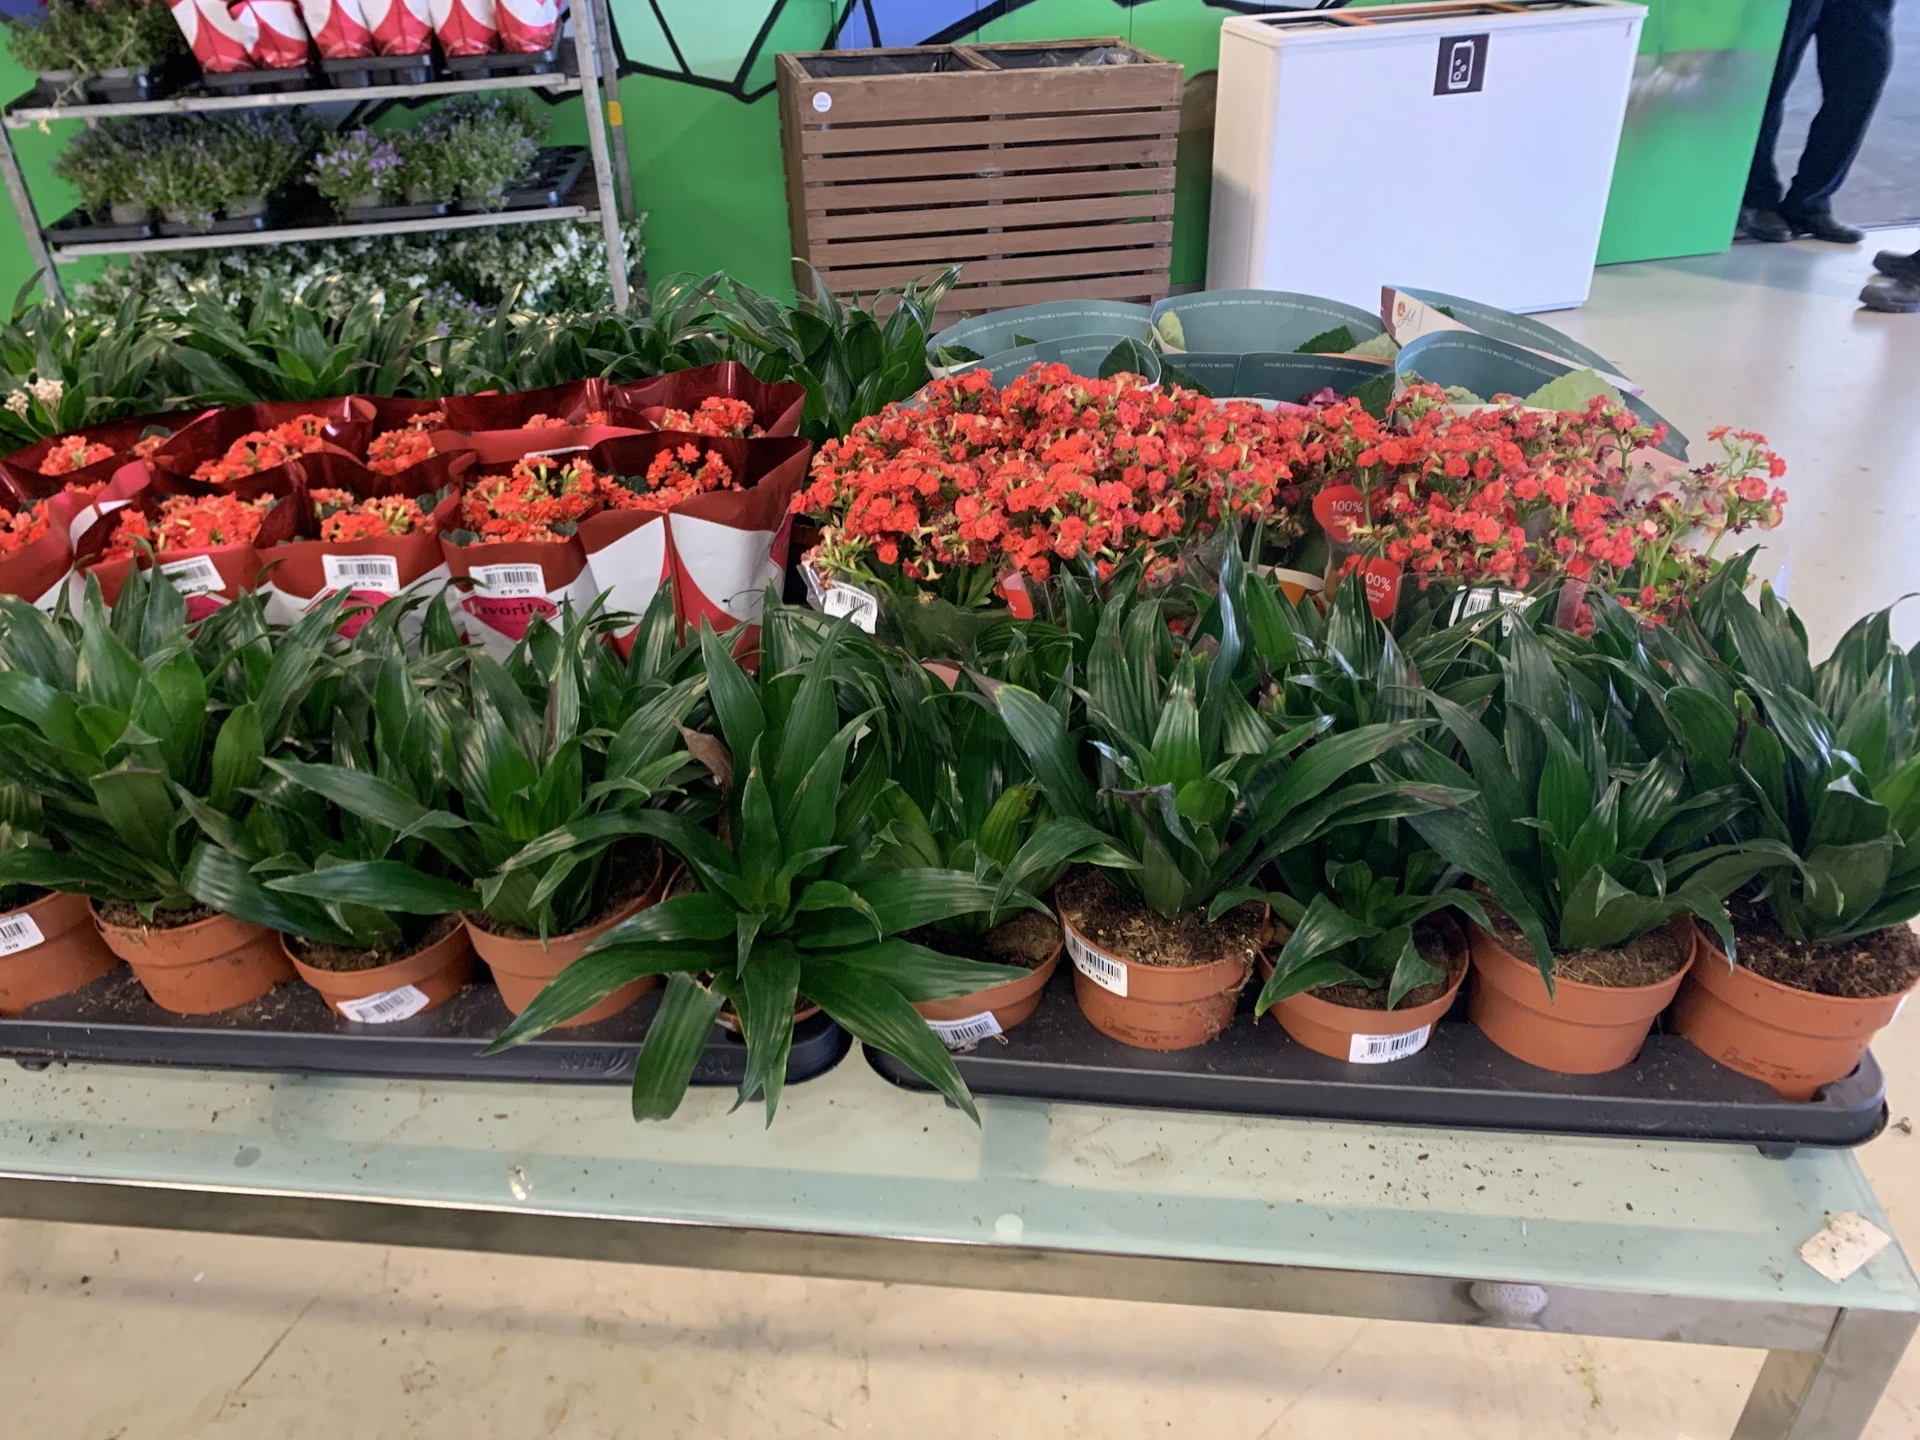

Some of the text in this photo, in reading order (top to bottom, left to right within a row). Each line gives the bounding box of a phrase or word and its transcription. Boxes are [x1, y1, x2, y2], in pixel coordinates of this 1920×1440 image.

[1331, 500, 1363, 513] 100%
[1361, 571, 1391, 592] 00%
[500, 587, 530, 596] €1.99
[1366, 588, 1385, 599] cycled
[1080, 963, 1109, 986] €1.99
